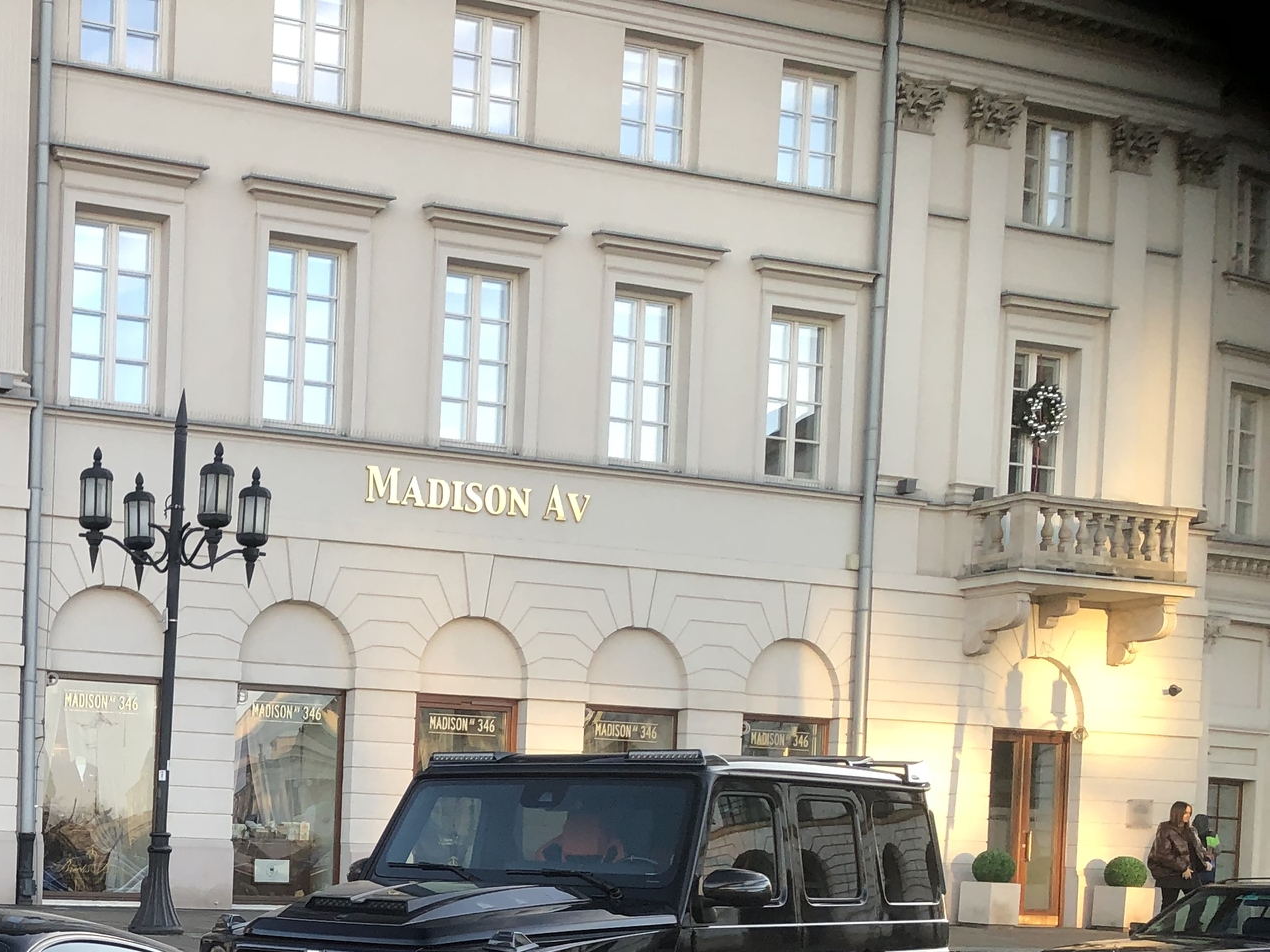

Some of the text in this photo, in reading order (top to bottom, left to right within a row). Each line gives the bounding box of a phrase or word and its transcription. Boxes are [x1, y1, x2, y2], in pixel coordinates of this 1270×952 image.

[365, 465, 591, 523] MADISON AV
[64, 692, 108, 709] MADISON
[118, 696, 138, 710] 346
[252, 703, 293, 719] MADISON
[302, 706, 322, 720] 346
[429, 716, 468, 731] MADISON
[477, 719, 495, 733] 346
[595, 723, 632, 738] MADISON
[640, 725, 657, 739] 346
[751, 732, 785, 746] MADISON
[793, 735, 809, 748] 346
